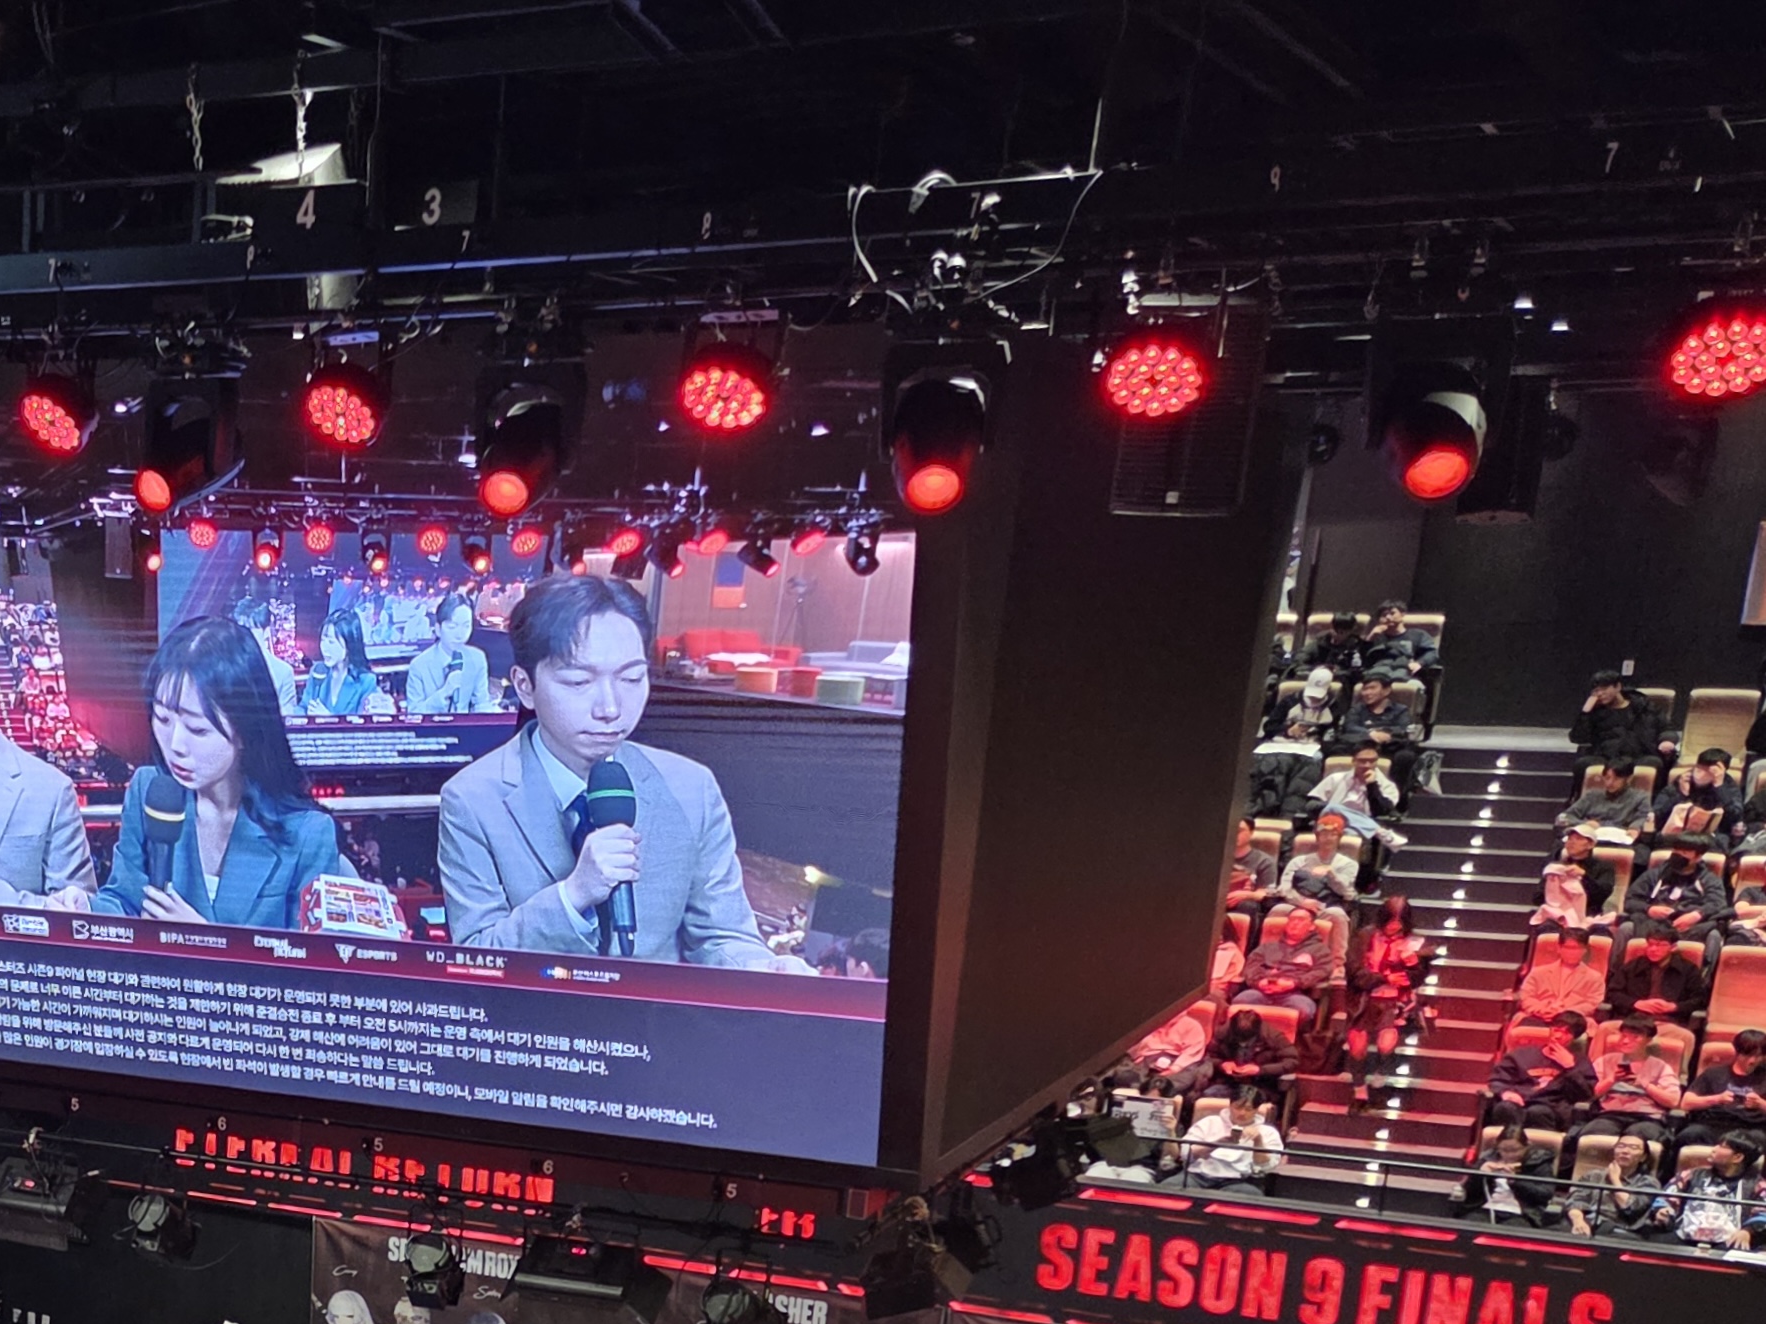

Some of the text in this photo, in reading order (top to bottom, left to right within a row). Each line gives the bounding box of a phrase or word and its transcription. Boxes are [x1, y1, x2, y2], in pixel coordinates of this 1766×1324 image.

[296, 189, 315, 229] 4
[422, 187, 440, 225] 3
[159, 931, 184, 945] BIPA
[425, 951, 505, 968] WD_BLACK
[27, 963, 53, 977] 시즌9
[55, 966, 84, 981] 파이널
[86, 969, 106, 983] 현장
[108, 970, 138, 986] 대기와
[226, 983, 247, 998] 현장
[249, 985, 280, 1001] 대기가
[284, 988, 326, 1006] 운영되지
[329, 993, 351, 1008] 못한
[354, 995, 387, 1012] 부분에
[389, 999, 412, 1014] 있어
[415, 1001, 488, 1023] 사과드립니다.
[12, 997, 39, 1012] 가능한
[42, 1000, 70, 1015] 시간이
[123, 1009, 173, 1026] 대기하시는
[175, 1015, 205, 1030] 인원이
[208, 1018, 249, 1035] 늘어나게
[347, 1033, 391, 1051] 어려움이
[394, 1038, 416, 1054] 있어
[419, 1041, 454, 1058] 그대로
[456, 1045, 490, 1063] 대기를
[494, 1050, 540, 1067] 진행하게
[543, 1054, 608, 1075] 되었습니다.
[40, 982, 60, 996] 너무
[62, 984, 81, 998] 이른
[83, 987, 122, 1003] 시간부터
[124, 991, 164, 1007] 대기하는
[166, 995, 186, 1010] 것을
[189, 998, 230, 1015] 제한하기
[233, 1002, 254, 1017] 위해
[256, 1005, 299, 1022] 준결승전
[339, 1013, 360, 1029] 부터
[363, 1016, 385, 1031] 오전
[388, 1018, 441, 1037] 5시까지는
[443, 1024, 466, 1040] 운영
[506, 1031, 531, 1047] 대기
[534, 1033, 570, 1051] 인원을
[573, 1037, 650, 1061] 해산시켰으나,
[22, 1016, 41, 1030] 위해
[43, 1018, 91, 1036] 방문해주신
[124, 1027, 144, 1041] 사전
[146, 1030, 177, 1045] 공지와
[178, 1033, 210, 1049] 다르게
[212, 1036, 253, 1054] 운영되어
[255, 1042, 276, 1057] 다시
[361, 1054, 383, 1069] 말씀
[386, 1057, 434, 1075] 드립니다.
[2, 1031, 22, 1045] 많은
[23, 1033, 52, 1048] 인원이
[54, 1037, 93, 1053] 경기장에
[95, 1041, 133, 1058] 입장하실
[147, 1048, 178, 1064] 있도록
[179, 1052, 220, 1069] 현장에서
[235, 1058, 266, 1074] 좌석이
[269, 1062, 301, 1079] 발생할
[303, 1066, 325, 1081] 경우
[362, 1073, 395, 1090] 안내를
[397, 1077, 420, 1093] 드릴
[422, 1080, 471, 1101] 예정이니,
[474, 1086, 508, 1104] 모바일
[511, 1090, 547, 1108] 알림을
[549, 1095, 622, 1117] 확인해주시면
[625, 1104, 717, 1128] 감사하겠습니다.
[71, 1097, 80, 1111] 5
[217, 1116, 226, 1130] 6
[373, 1136, 383, 1151] 5
[543, 1159, 553, 1174] 6
[726, 1183, 737, 1198] 5
[1036, 1223, 1286, 1321] SEASON
